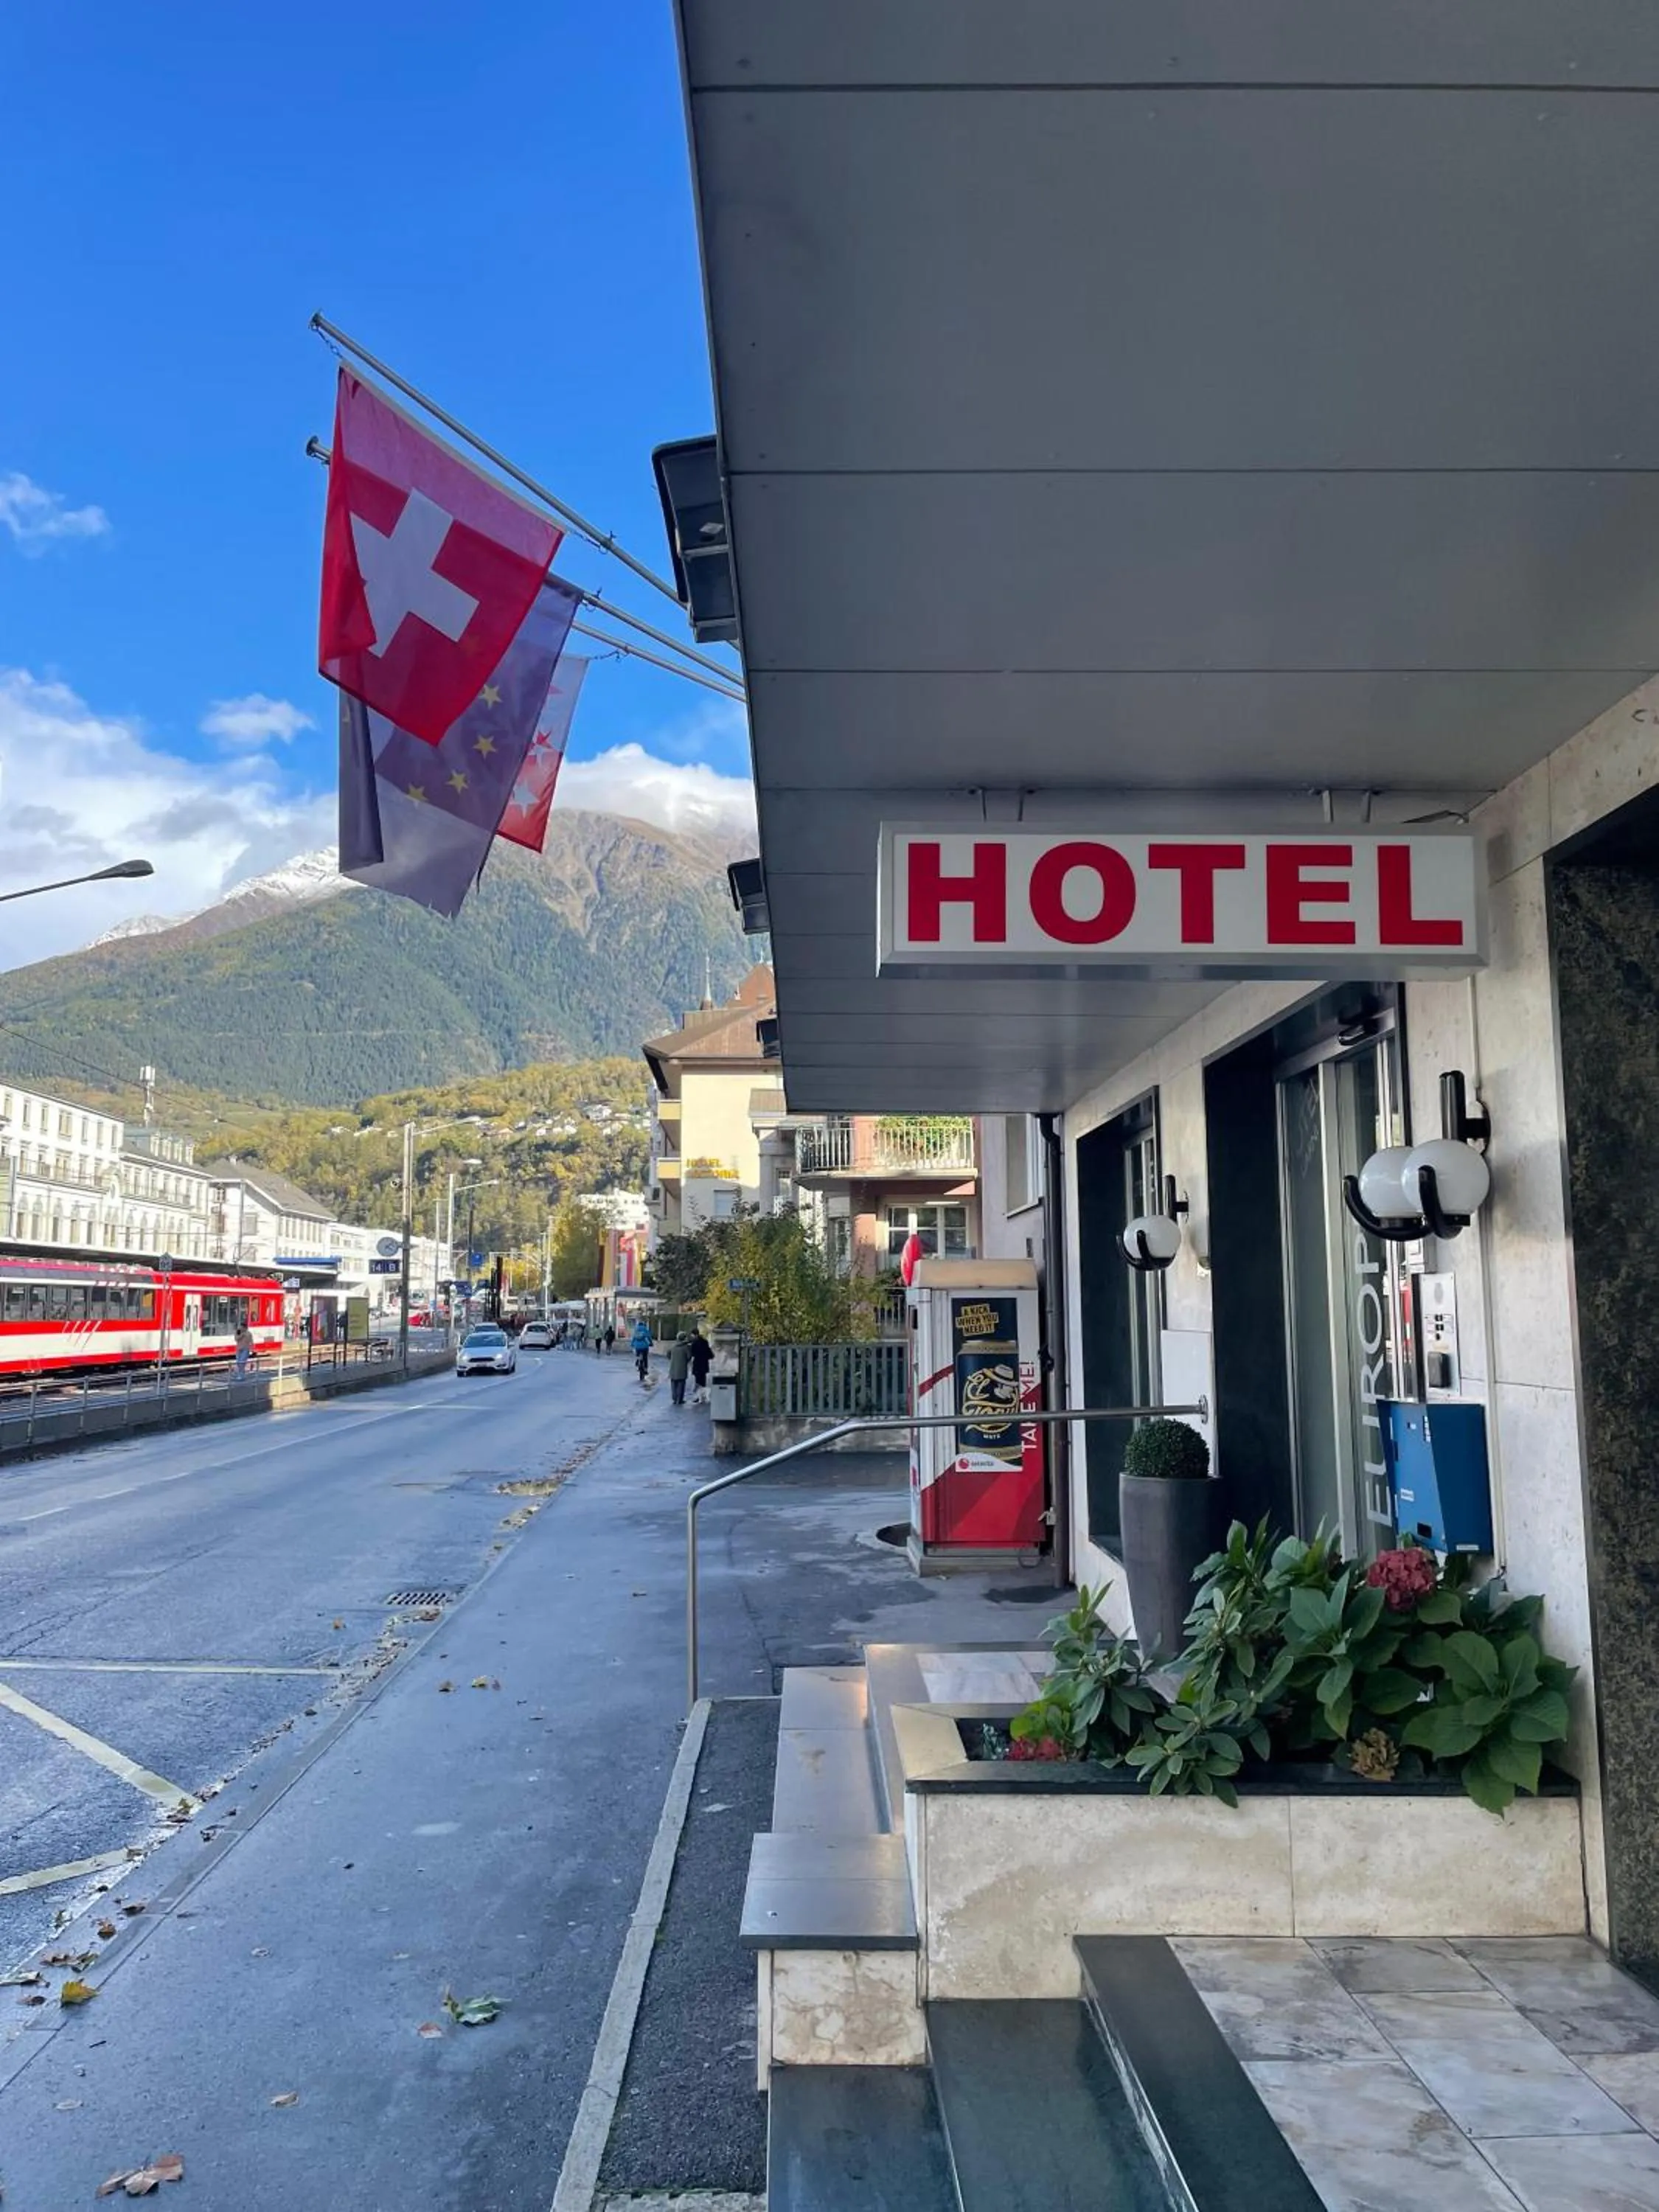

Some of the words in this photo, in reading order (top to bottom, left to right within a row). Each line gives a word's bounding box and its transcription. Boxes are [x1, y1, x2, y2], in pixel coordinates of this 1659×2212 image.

[908, 841, 1463, 945] HOTEL
[957, 1316, 981, 1326] WHEN
[1355, 1232, 1392, 1527] EUROP
